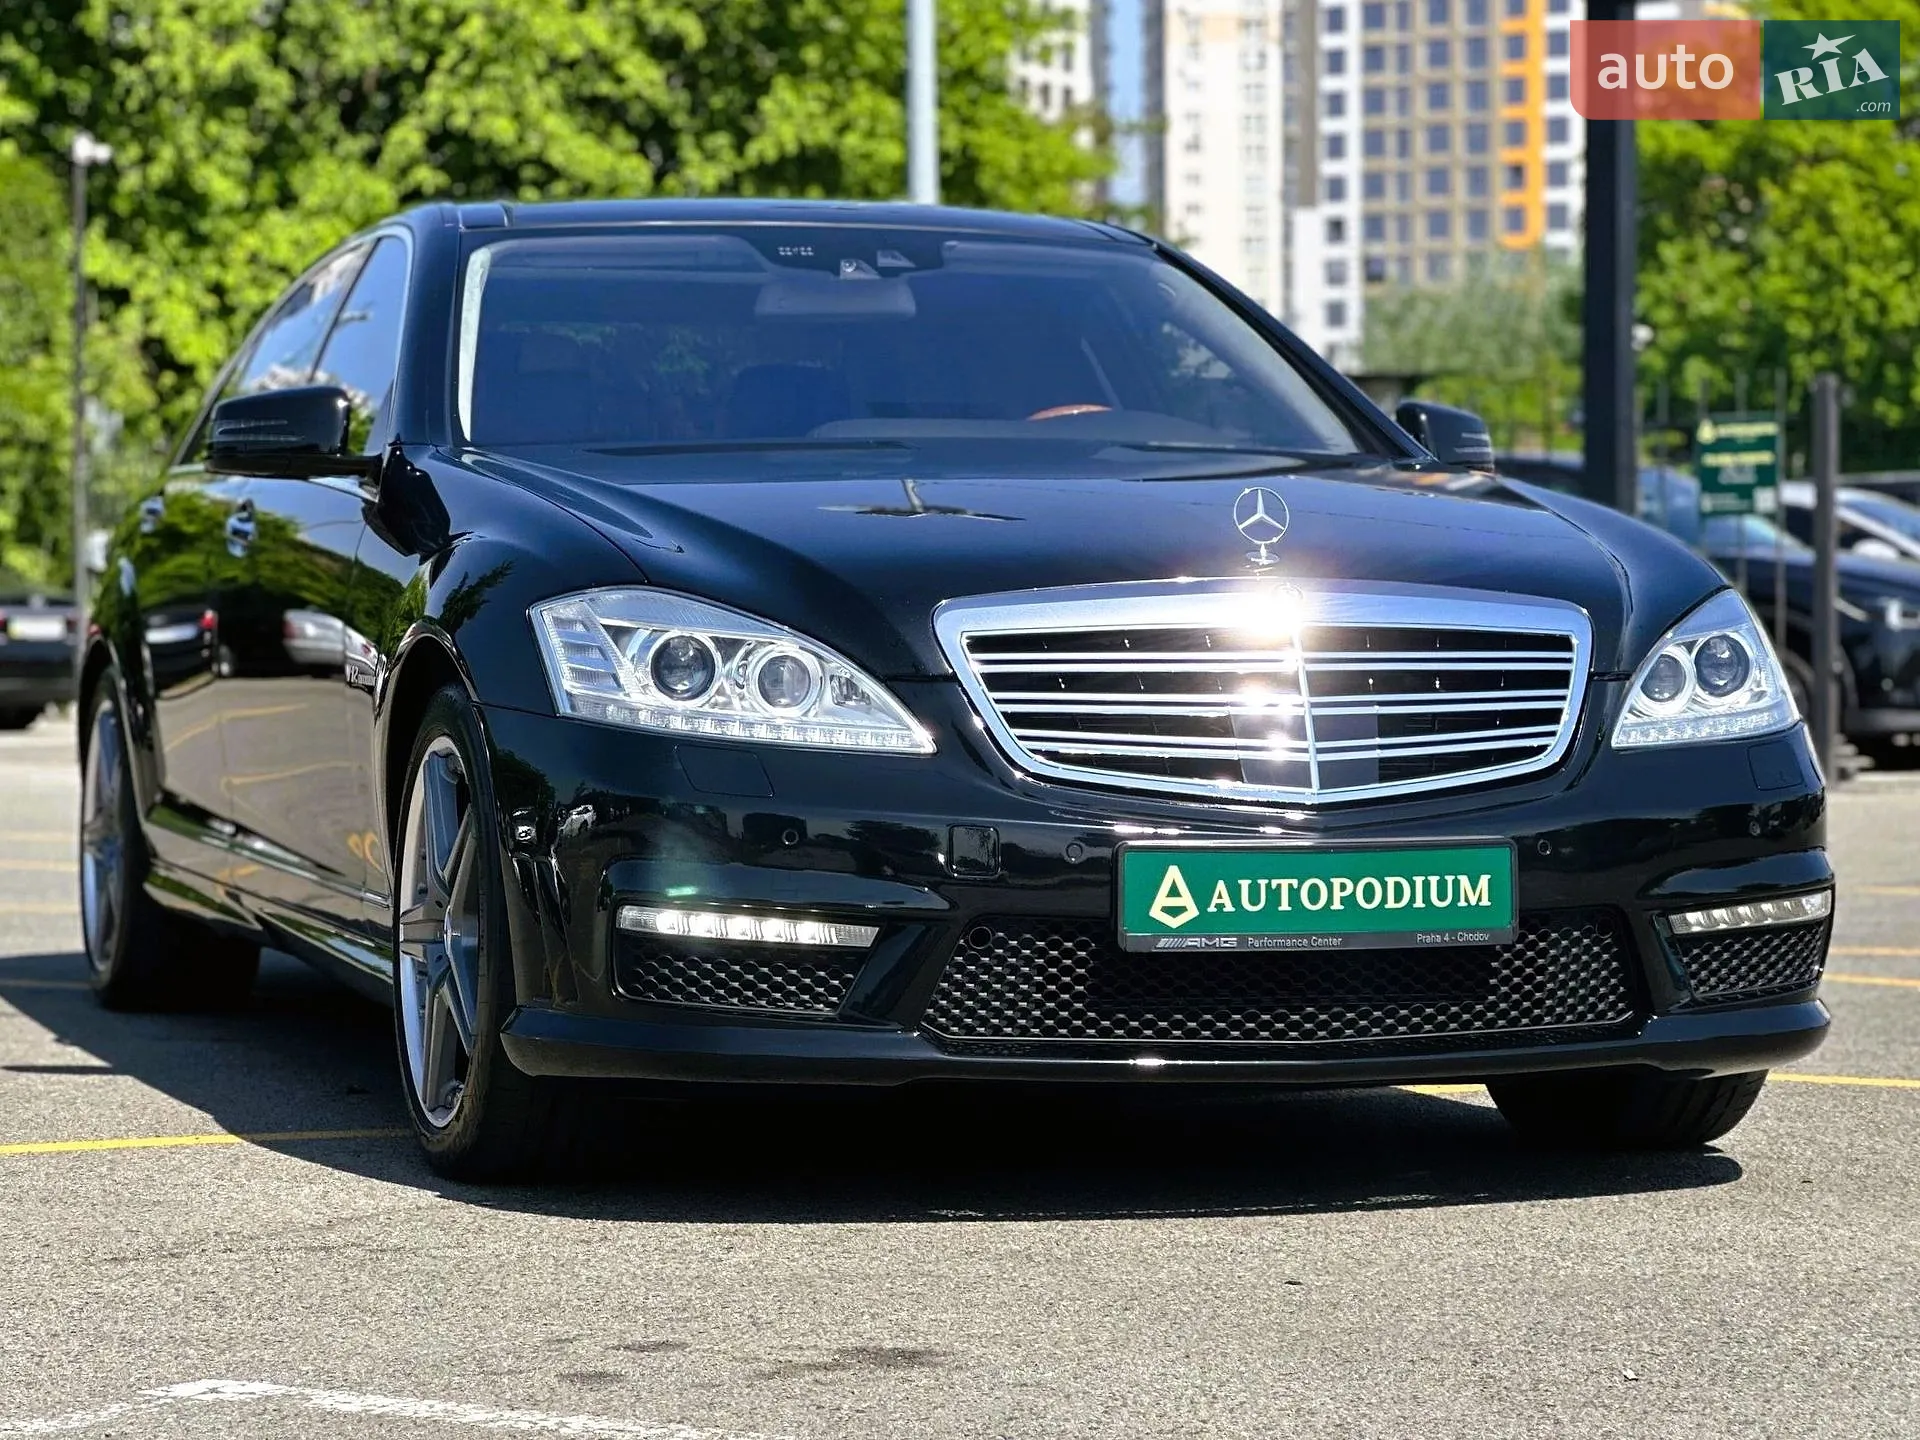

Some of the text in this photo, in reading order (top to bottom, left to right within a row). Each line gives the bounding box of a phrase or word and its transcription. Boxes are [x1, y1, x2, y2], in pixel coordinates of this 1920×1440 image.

[1207, 874, 1492, 913] AUTOPODIUM
[1181, 936, 1342, 948] AMG Performance Center
[1416, 932, 1442, 943] Praha
[1443, 932, 1450, 942] 4
[1457, 931, 1490, 942] Chodov
